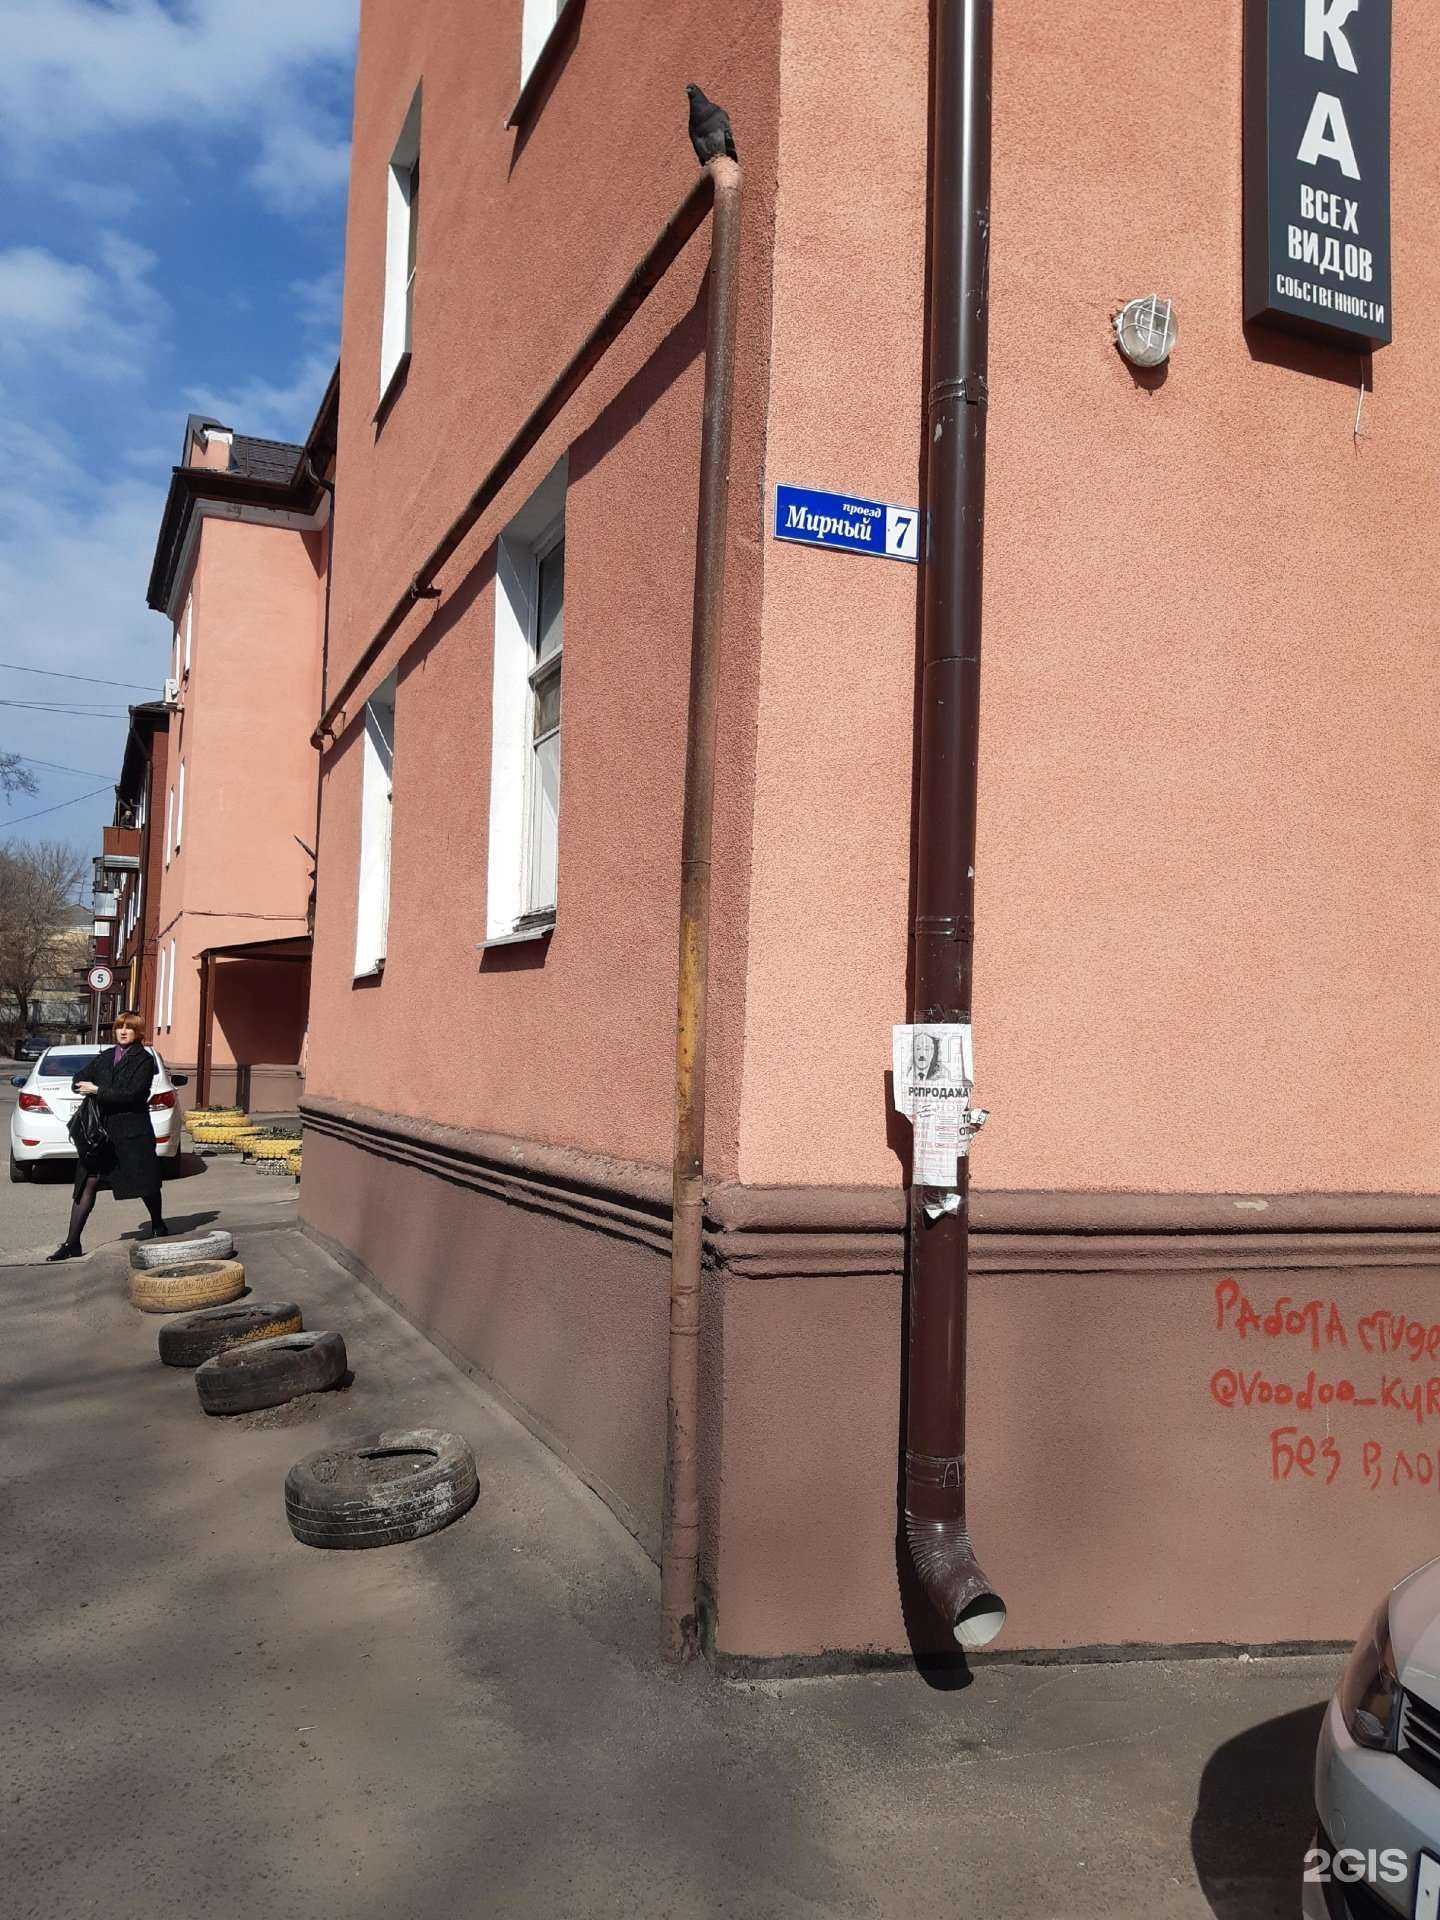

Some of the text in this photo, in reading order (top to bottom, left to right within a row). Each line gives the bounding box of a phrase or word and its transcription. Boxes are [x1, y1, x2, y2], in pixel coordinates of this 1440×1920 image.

[1300, 183, 1360, 235] ВСЕХ
[1287, 224, 1373, 282] ВИДОВ
[1276, 273, 1385, 324] СОБСТВЕННОСТИ
[785, 505, 911, 548] Мирный 7
[843, 503, 881, 518] проезд
[97, 973, 104, 983] 5
